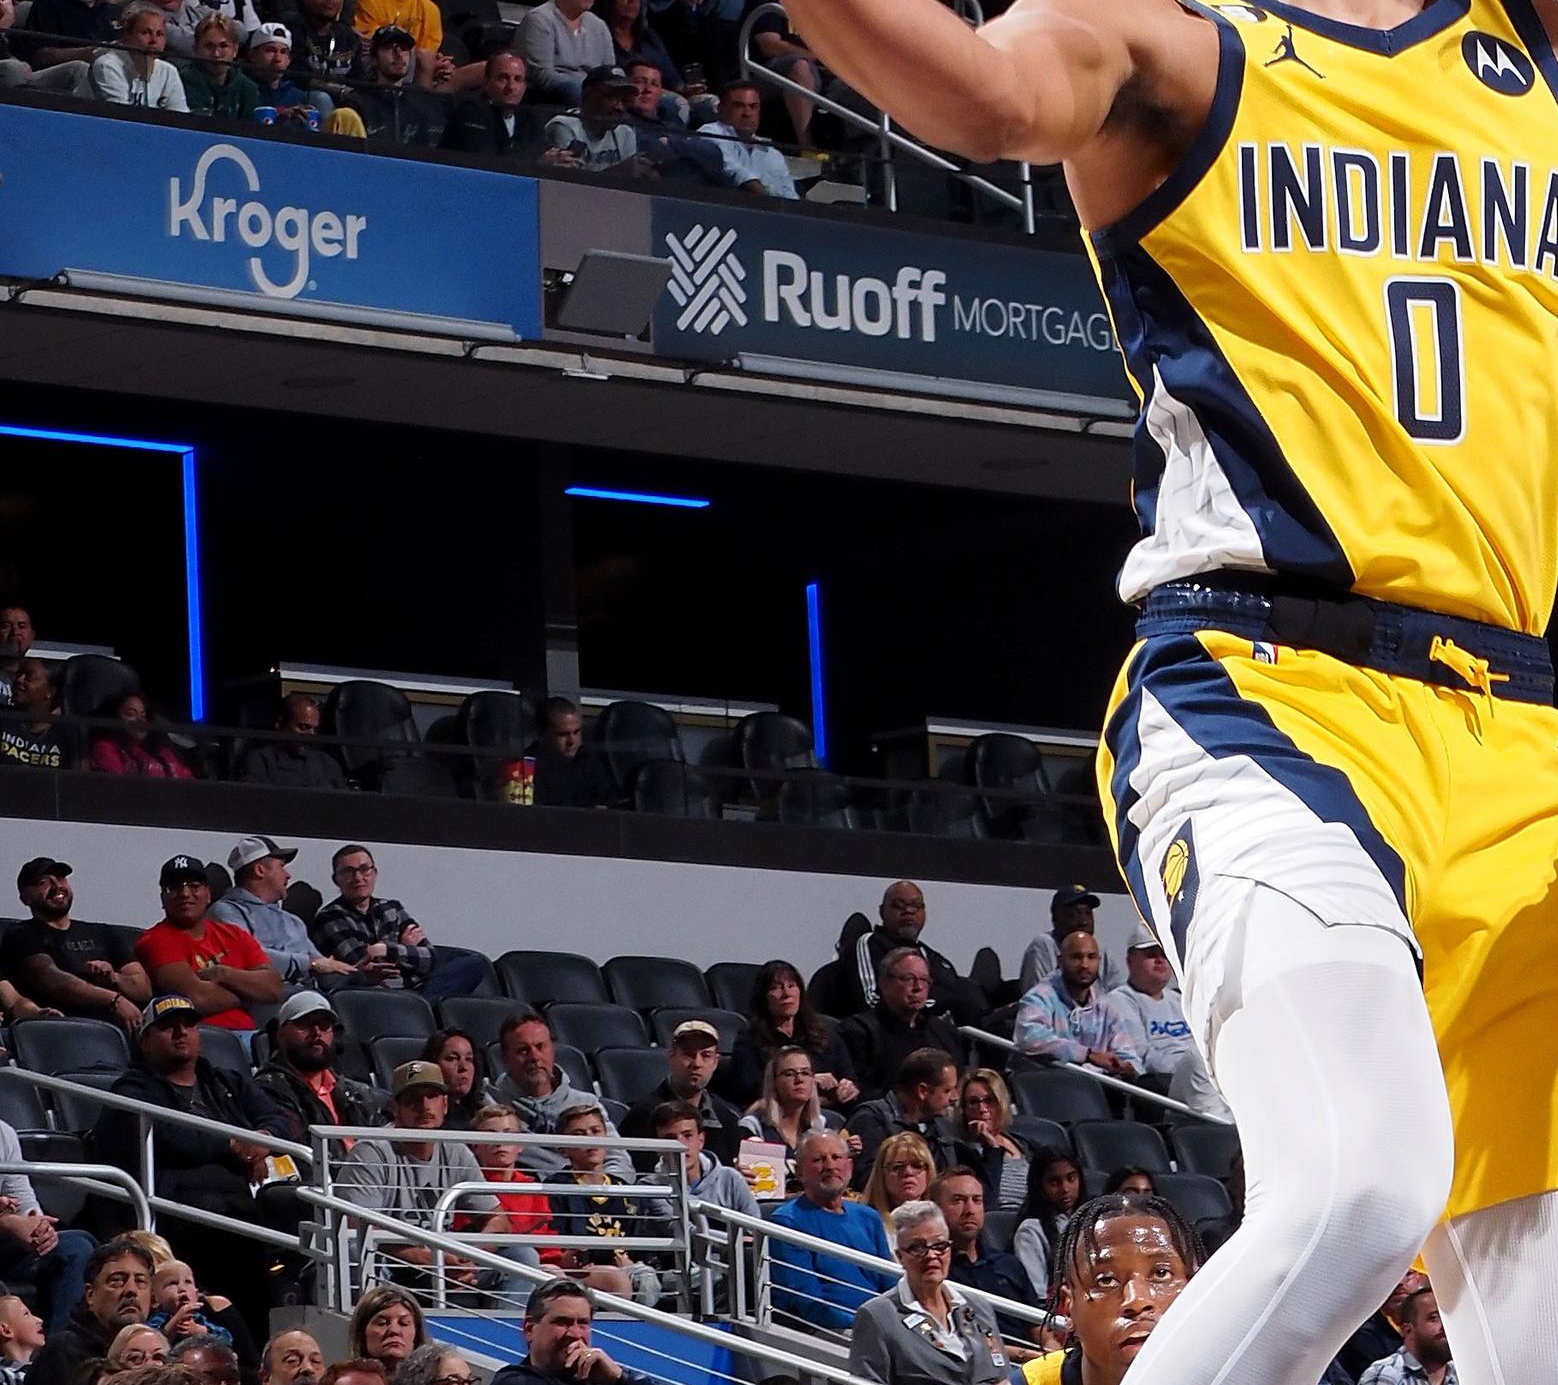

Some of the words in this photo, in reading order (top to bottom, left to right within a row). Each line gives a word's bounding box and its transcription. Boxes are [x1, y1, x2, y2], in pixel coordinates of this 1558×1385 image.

[169, 143, 367, 300] Kroger
[763, 249, 946, 343] Ruoff
[1383, 274, 1466, 446] 0
[1, 730, 61, 755] INDIANA
